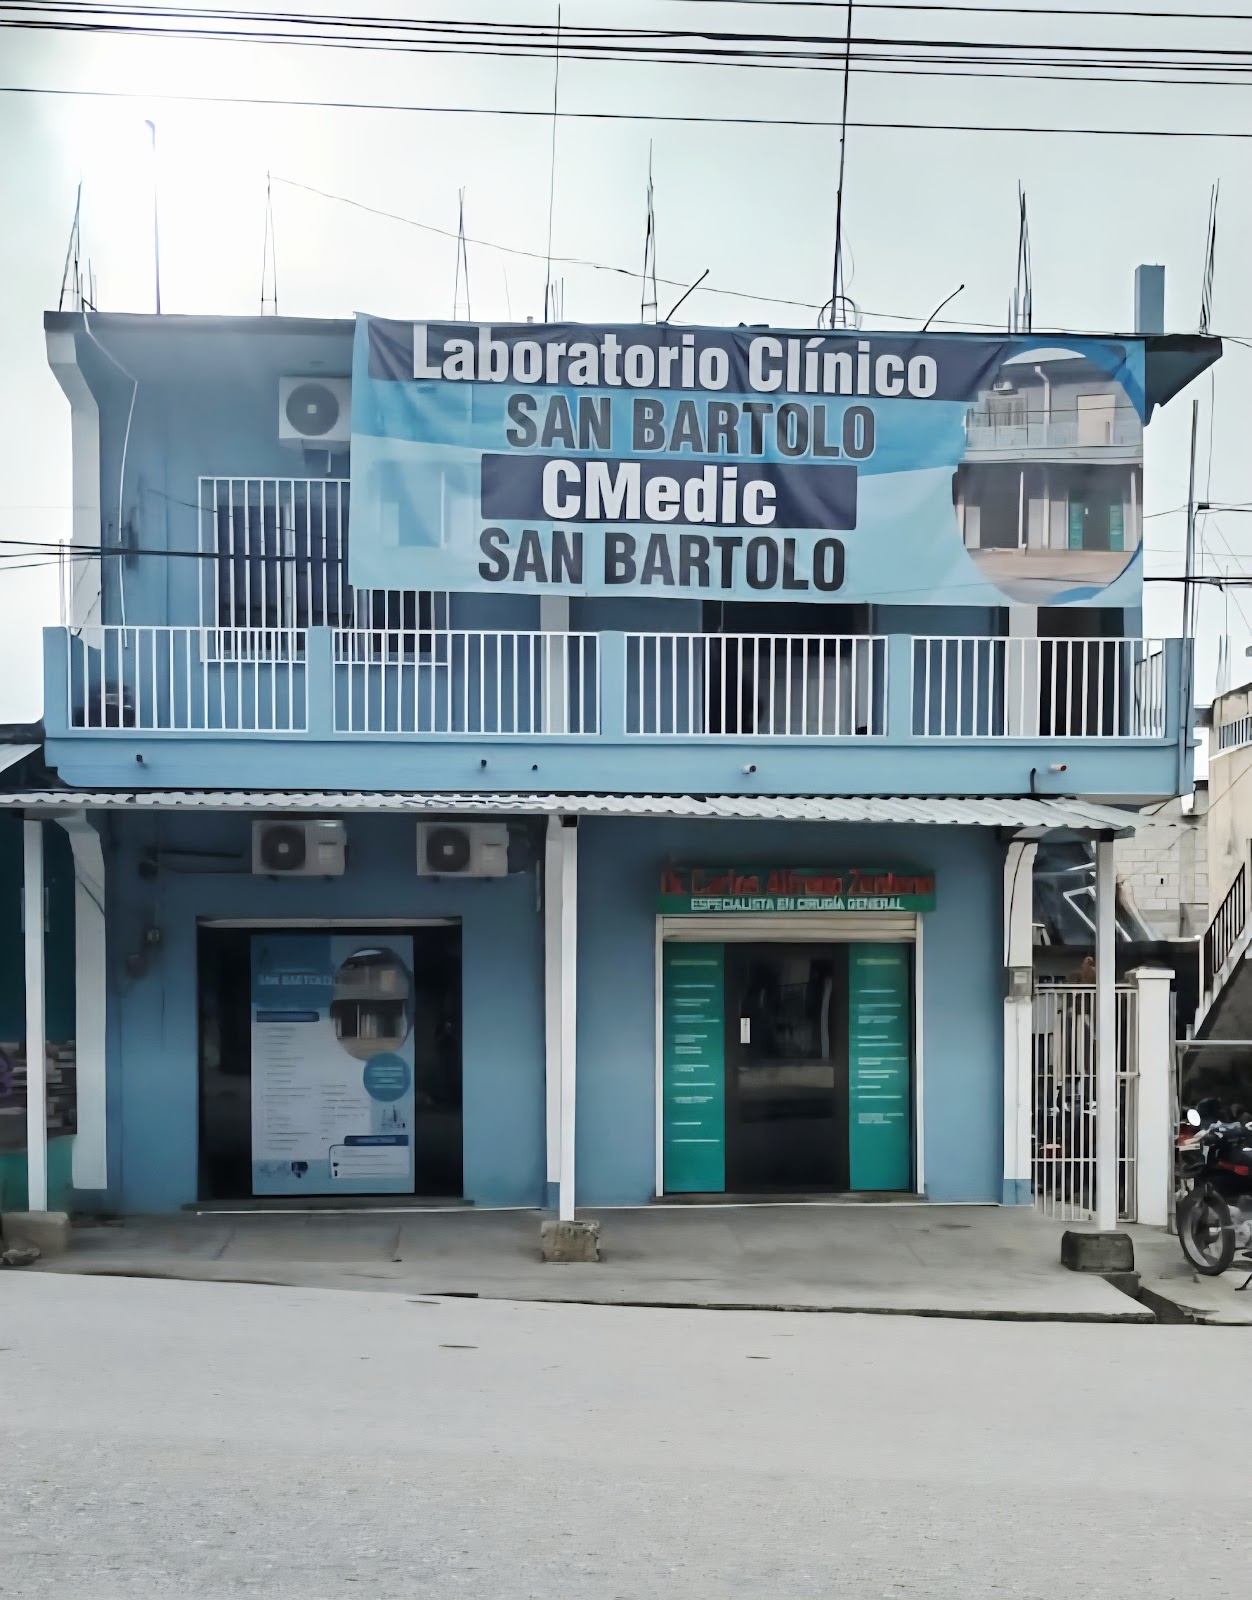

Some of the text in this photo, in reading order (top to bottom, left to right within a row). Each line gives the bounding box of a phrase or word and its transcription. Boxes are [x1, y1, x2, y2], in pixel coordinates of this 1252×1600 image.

[413, 323, 937, 398] Laboratorio Clínico
[506, 393, 875, 458] SAN BARTOLO
[542, 459, 777, 525] CMedic
[478, 527, 846, 592] SAN BARTOLO
